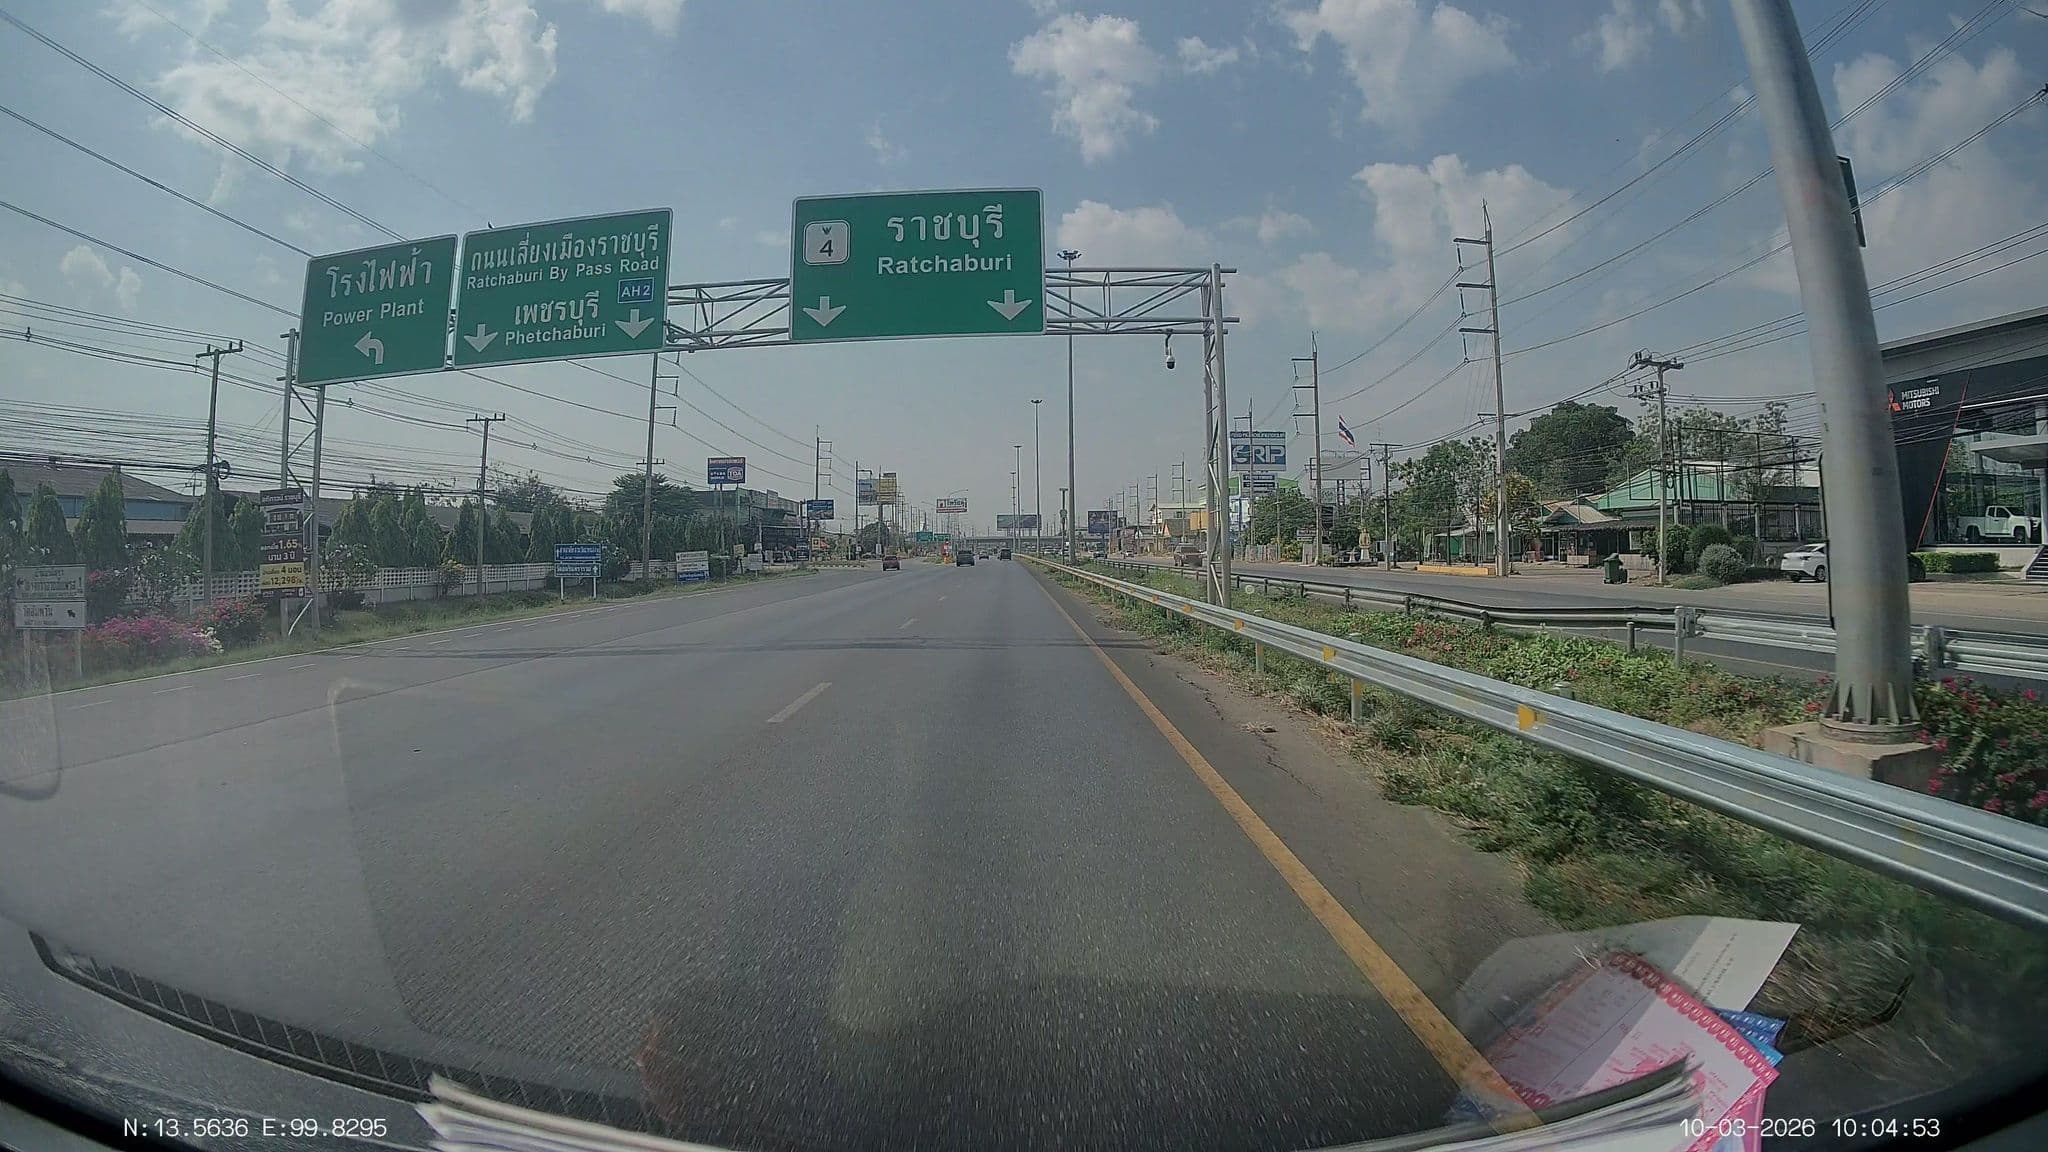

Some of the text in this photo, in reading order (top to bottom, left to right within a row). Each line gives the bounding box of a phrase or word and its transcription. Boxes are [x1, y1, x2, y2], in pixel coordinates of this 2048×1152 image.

[887, 203, 1003, 248] ราชบุรี
[470, 223, 659, 272] ถนนเลี่ยงเมืองราชบุรี
[818, 238, 834, 258] 4
[326, 247, 432, 298] โรงไฟฟ้า
[466, 256, 659, 290] Ratchaburi By Pass Road
[877, 253, 1012, 275] Ratchaburi
[323, 298, 425, 328] Power Plant
[514, 290, 599, 326] เพชรบุรี
[505, 322, 606, 346] Phetchaburi
[1901, 386, 1940, 400] MITSUBISHI
[1902, 397, 1931, 410] MOTORS
